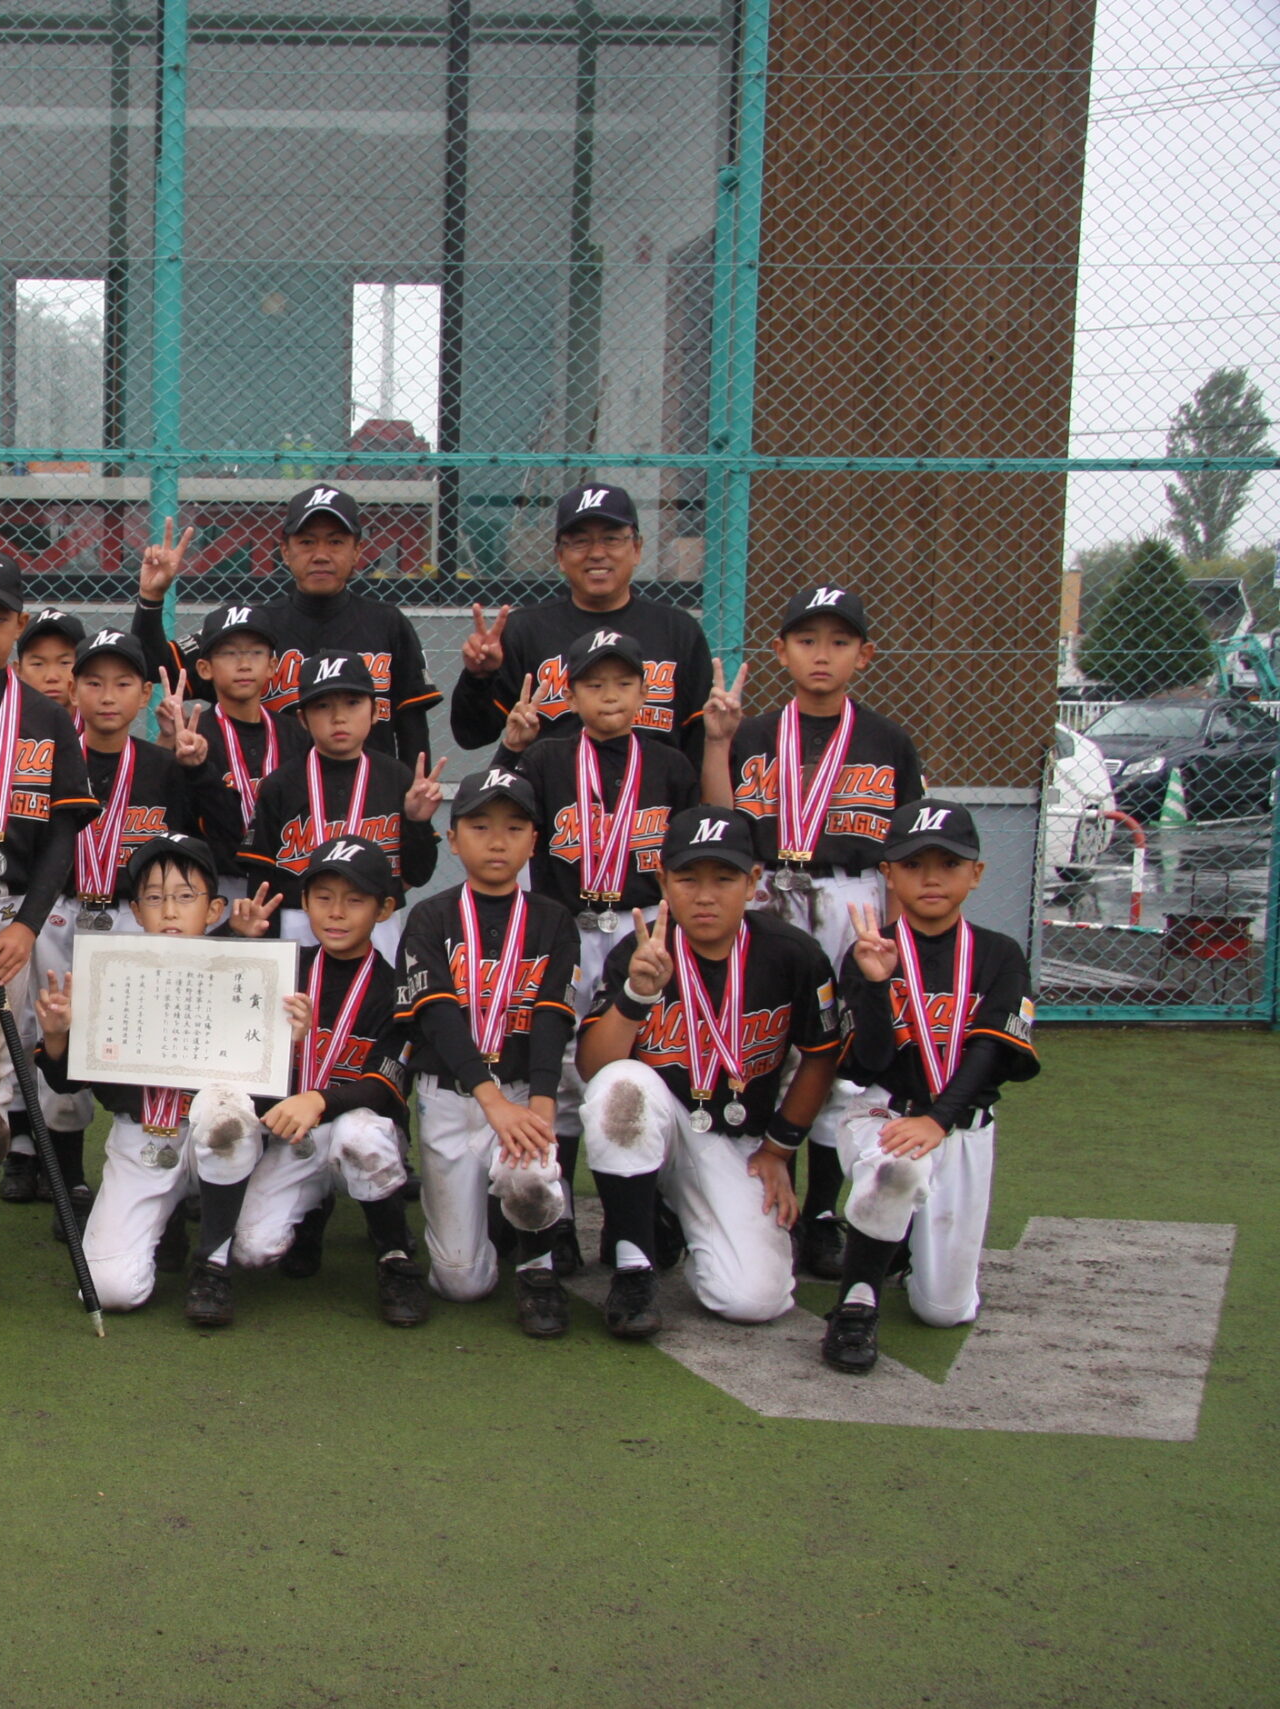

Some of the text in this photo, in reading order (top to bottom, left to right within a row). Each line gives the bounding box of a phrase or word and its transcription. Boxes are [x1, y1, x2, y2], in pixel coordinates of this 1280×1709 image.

[305, 488, 339, 508] M
[576, 489, 609, 513] M
[806, 587, 845, 609] M
[36, 609, 67, 624] M
[222, 606, 253, 629] M
[89, 629, 125, 650] M
[587, 630, 622, 653] M
[313, 657, 348, 685] M
[480, 769, 517, 791] M
[690, 818, 729, 844] M
[824, 810, 892, 843] EAGLE
[908, 807, 952, 834] M
[322, 840, 365, 863] M
[232, 973, 244, 1003] 準優勝
[245, 993, 263, 1042] 賞状
